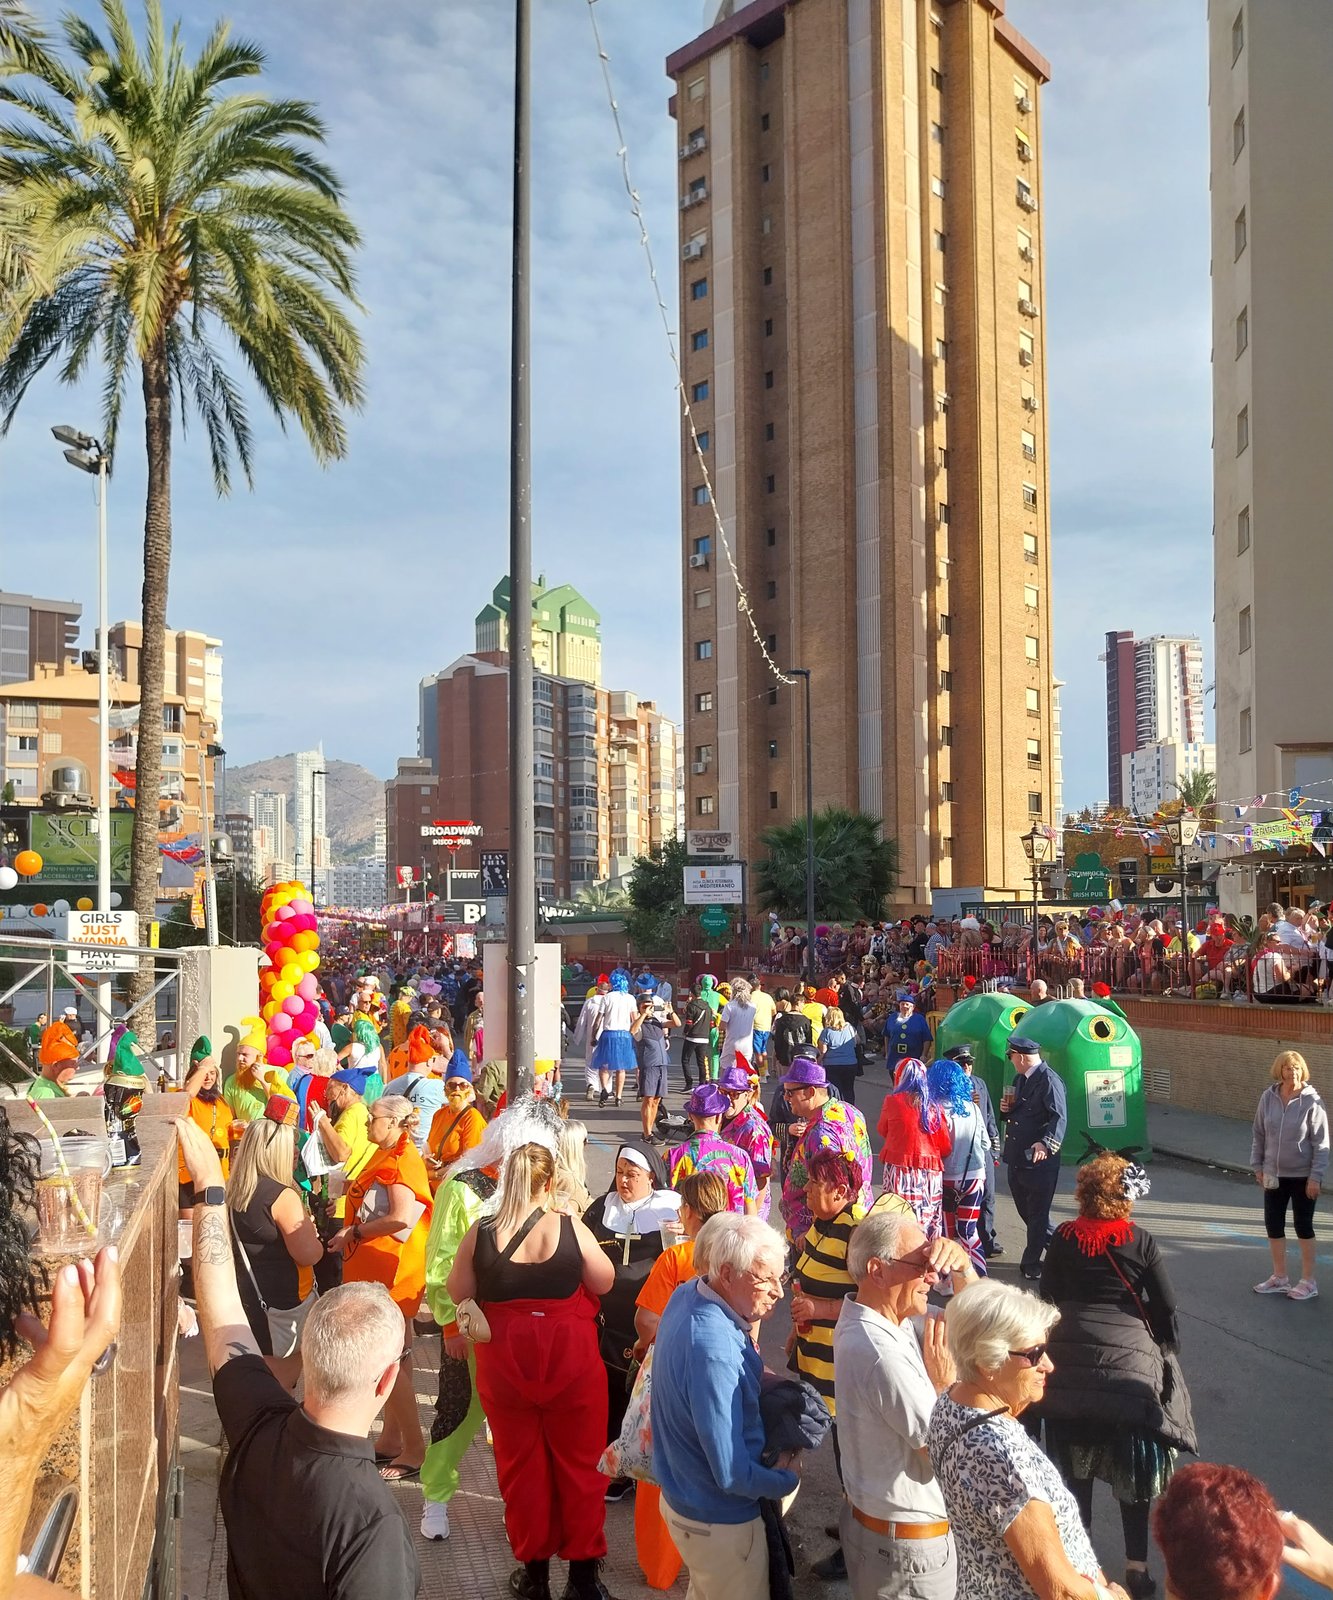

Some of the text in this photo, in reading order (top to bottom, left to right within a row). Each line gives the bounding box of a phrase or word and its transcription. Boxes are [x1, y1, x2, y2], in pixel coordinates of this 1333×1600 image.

[421, 825, 482, 837] BROADWAY
[433, 838, 453, 846] DISCO
[80, 913, 122, 924] GIRLS
[82, 925, 120, 935] JUST
[72, 937, 129, 946] WANNA
[80, 951, 121, 959] HAVE
[85, 960, 116, 971] SUN
